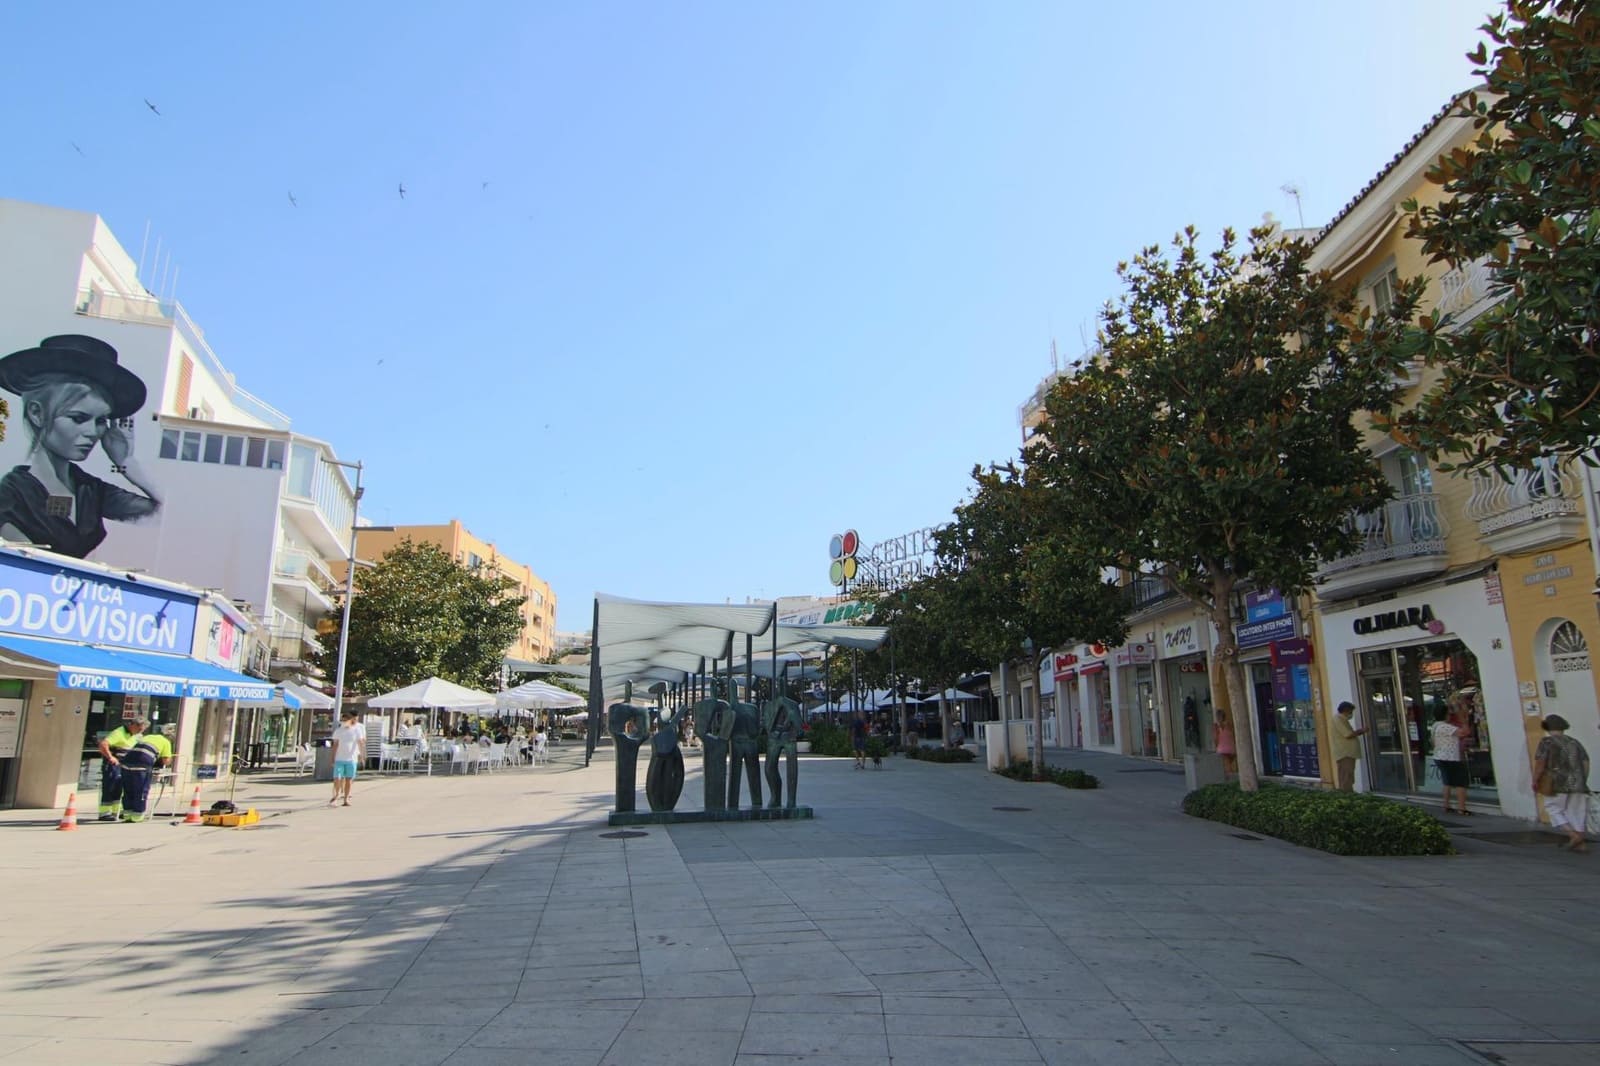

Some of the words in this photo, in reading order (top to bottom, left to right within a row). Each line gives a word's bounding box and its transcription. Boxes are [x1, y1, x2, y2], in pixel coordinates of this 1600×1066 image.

[51, 569, 123, 606] ÓPTICA
[68, 673, 109, 689] OPTICA
[120, 678, 176, 695] TODOVISION
[192, 685, 220, 698] OPTICA
[229, 686, 270, 700] TODOVISION
